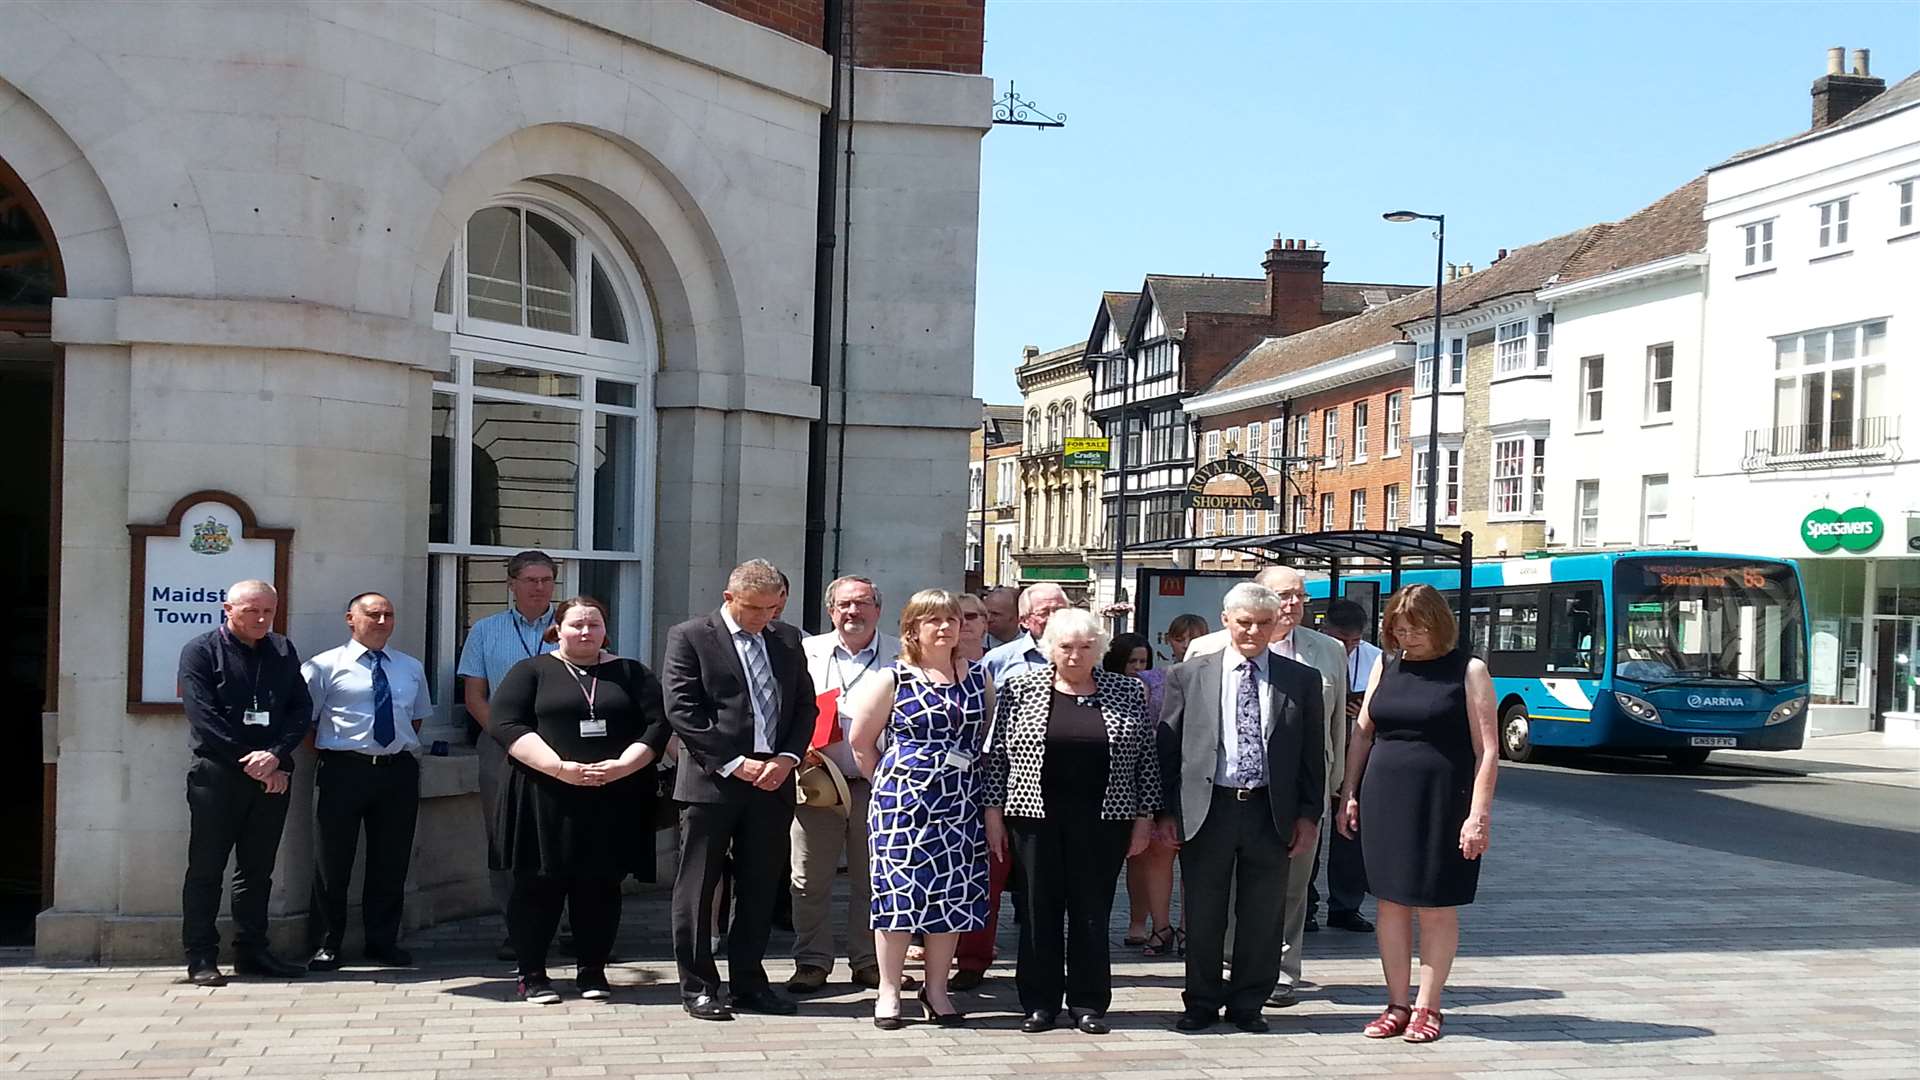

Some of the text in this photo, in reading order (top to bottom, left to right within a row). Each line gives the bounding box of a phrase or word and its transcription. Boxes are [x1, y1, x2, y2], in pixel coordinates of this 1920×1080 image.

[1189, 460, 1267, 494] ROYAL STAR
[1192, 495, 1262, 509] SHOPPING
[1806, 520, 1873, 539] Specsavers
[152, 586, 227, 602] Maidst
[153, 608, 212, 624] Town
[1703, 697, 1745, 706] ARRIVA
